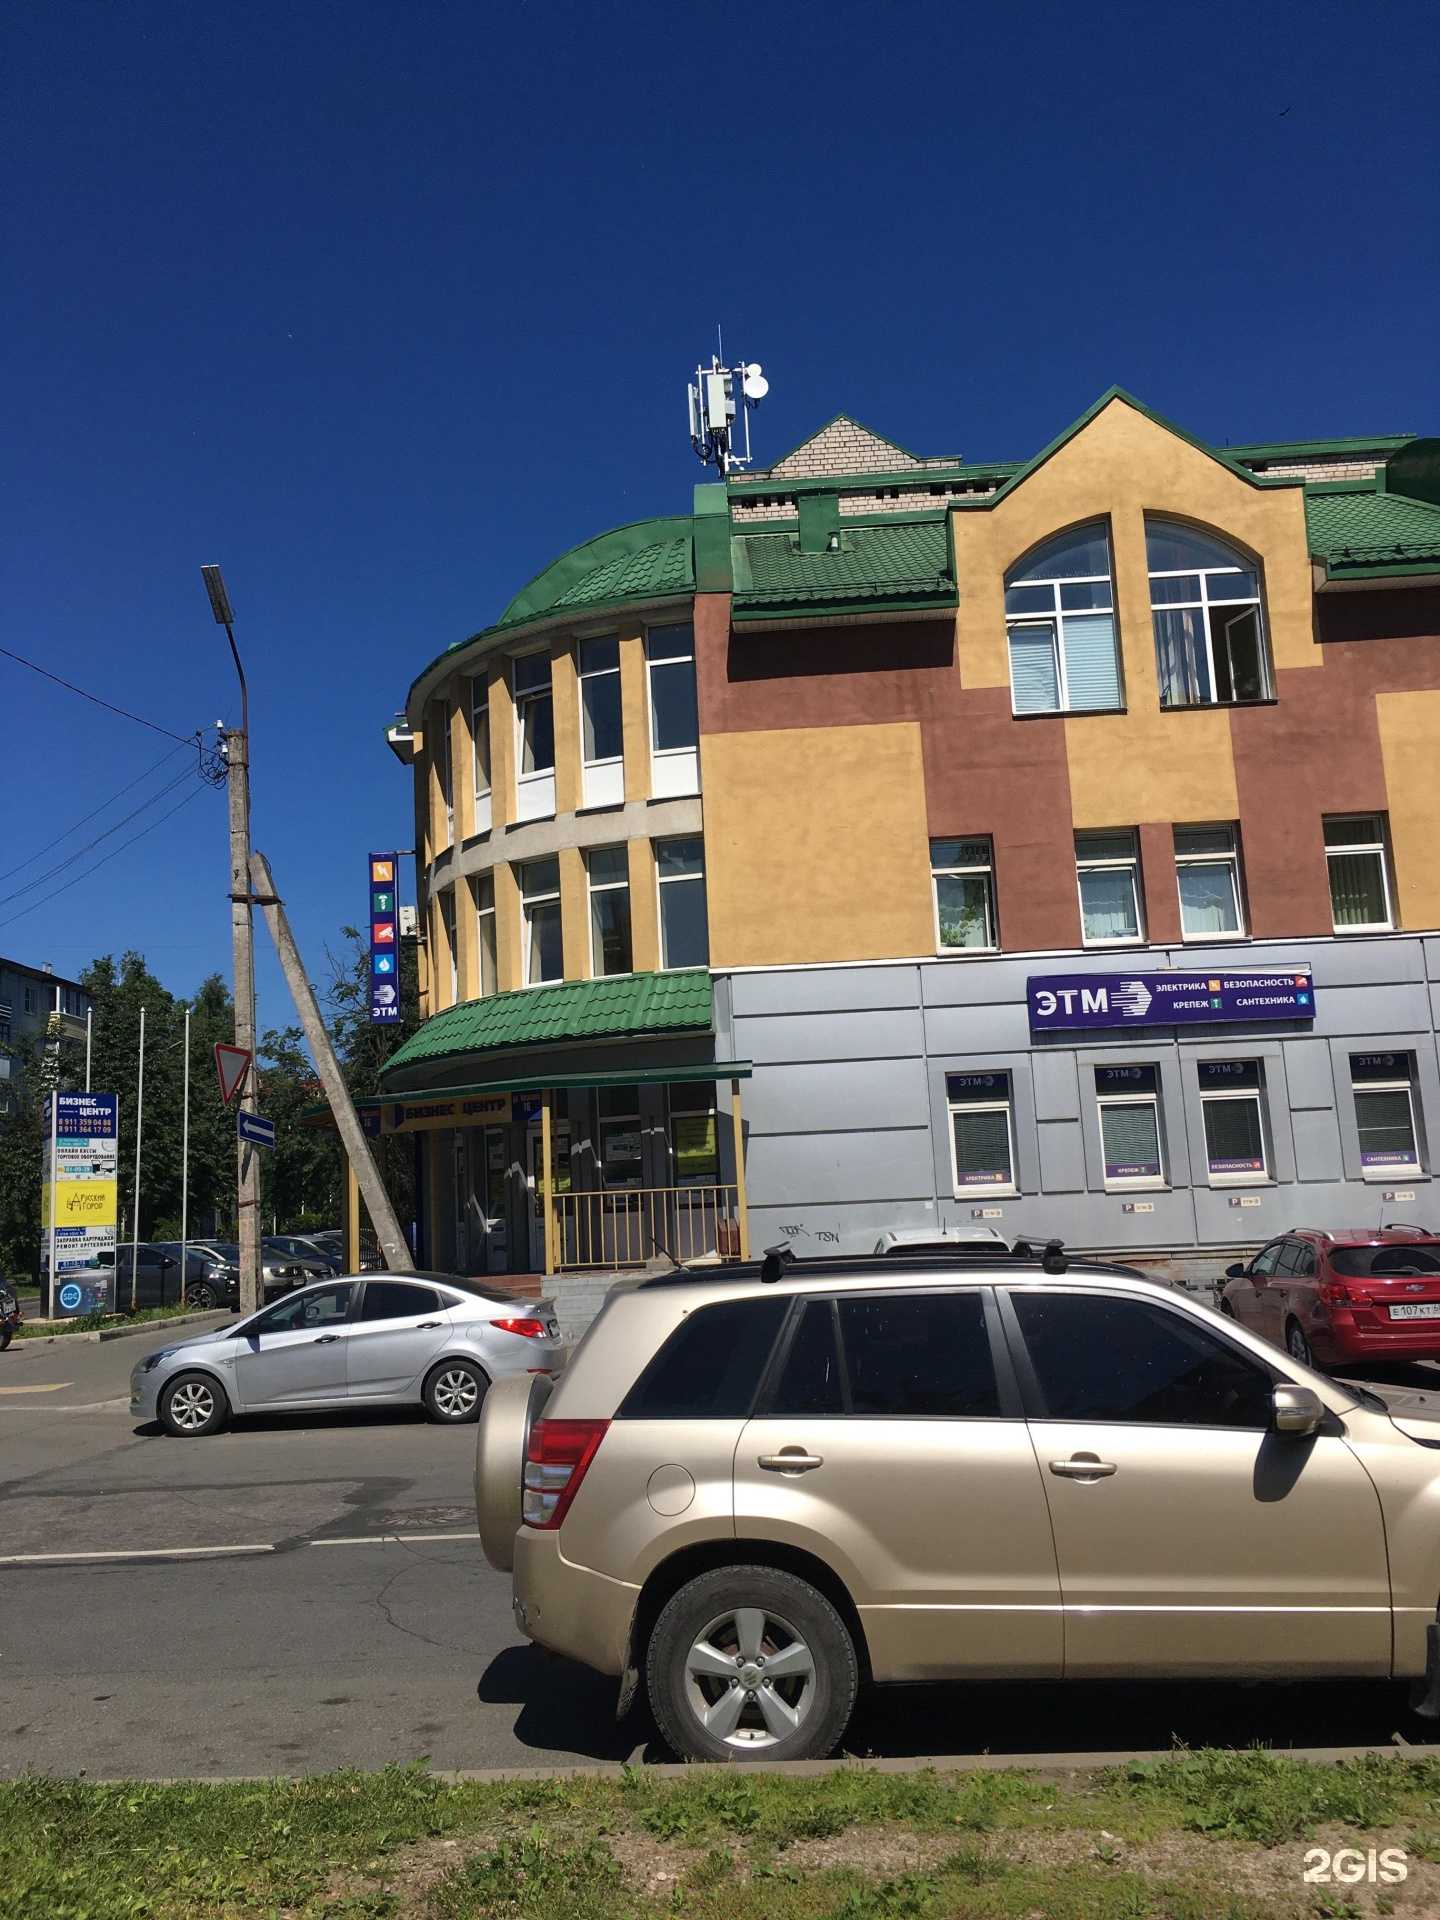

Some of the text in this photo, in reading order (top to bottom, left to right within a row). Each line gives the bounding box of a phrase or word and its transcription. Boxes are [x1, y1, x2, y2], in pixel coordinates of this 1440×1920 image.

[1156, 978, 1294, 992] ЭЛЕКТРИКА БЕЗОПАСНОСТЬ
[1035, 987, 1109, 1016] ЭТМ
[1173, 996, 1295, 1009] КРЕПЕЖ САНТЕХНИКА
[372, 1006, 398, 1017] ЭТМ
[1106, 1069, 1129, 1079] ЭТМ
[58, 1097, 97, 1106] БИЗНЕС
[79, 1107, 112, 1117] ЦЕНТР
[405, 1104, 455, 1119] БИЗНЕС
[463, 1098, 506, 1115] ЦЕНТР
